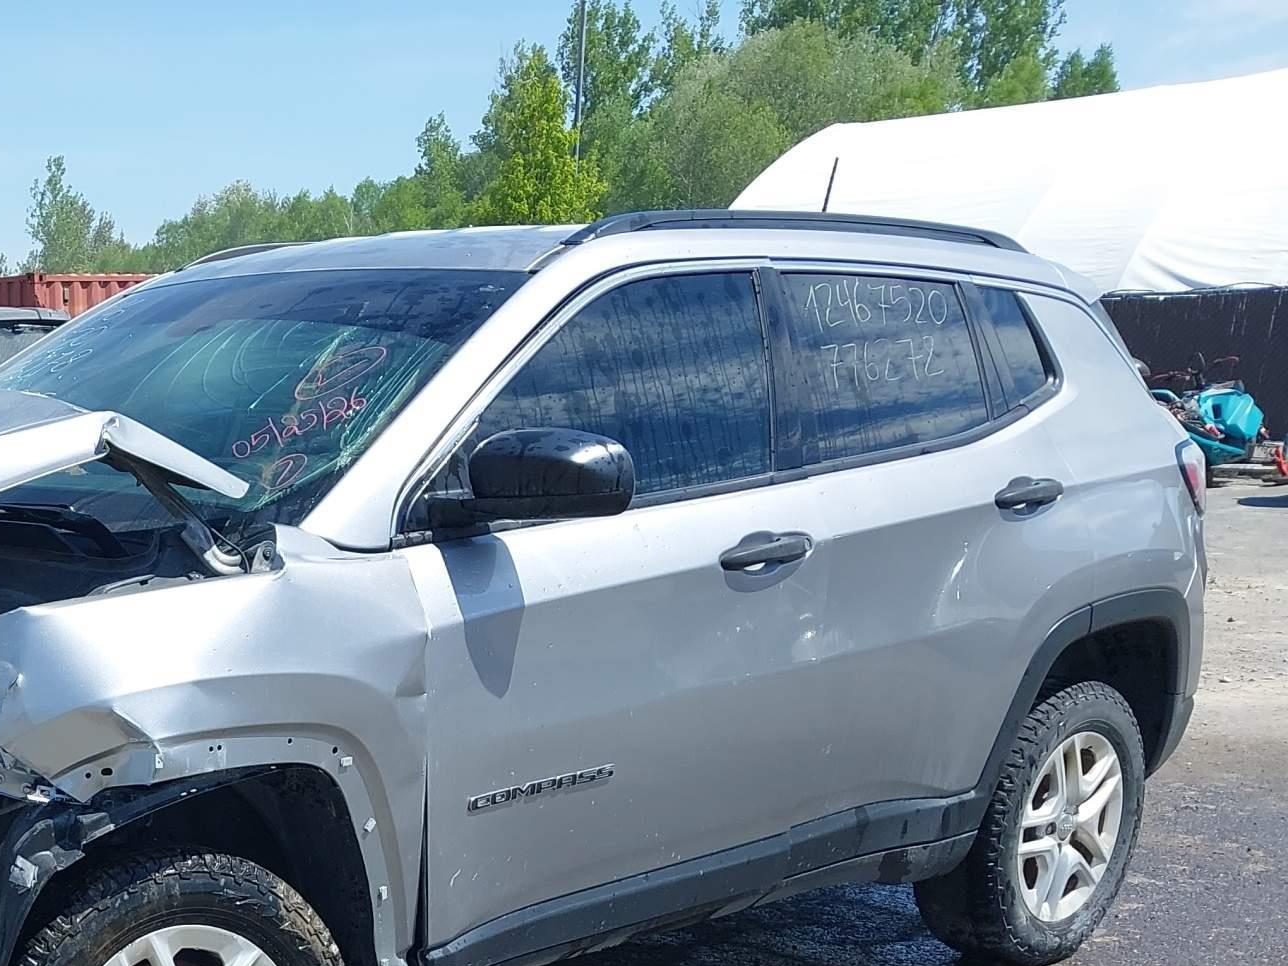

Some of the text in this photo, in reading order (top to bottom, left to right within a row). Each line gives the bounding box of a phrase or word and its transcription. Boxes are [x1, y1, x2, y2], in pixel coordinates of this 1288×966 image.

[804, 278, 948, 333] 12467520
[820, 336, 945, 389] 776272
[467, 763, 616, 812] COMPASS
